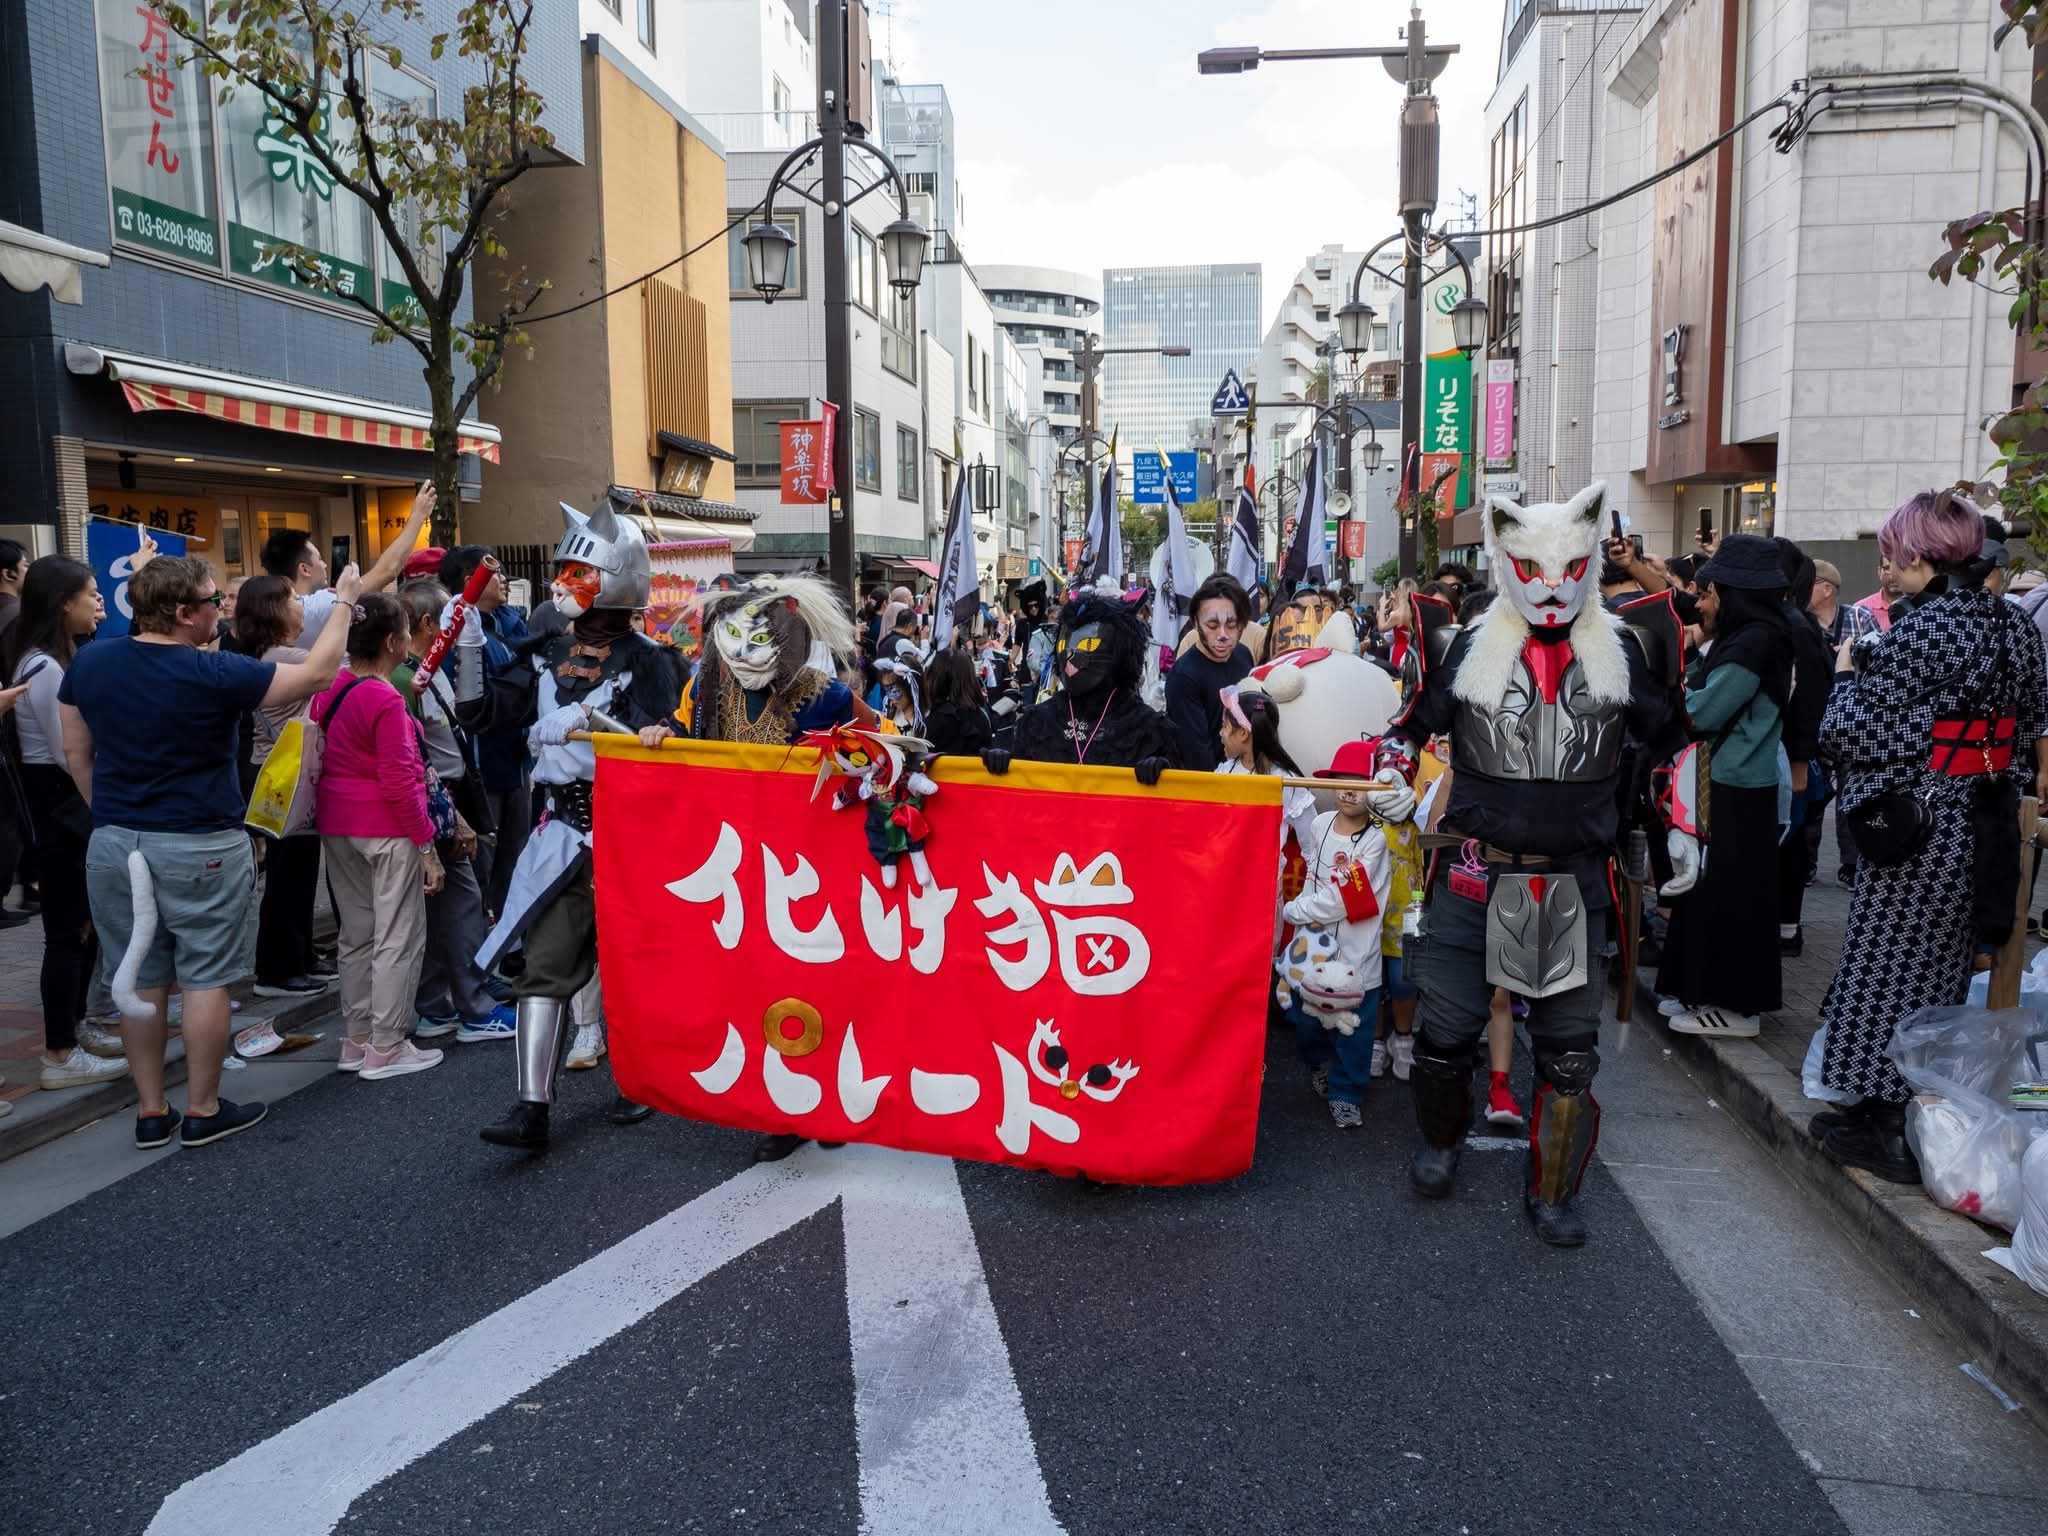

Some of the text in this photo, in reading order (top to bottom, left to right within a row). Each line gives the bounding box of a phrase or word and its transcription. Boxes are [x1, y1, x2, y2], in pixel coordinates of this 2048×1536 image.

[137, 210, 214, 256] 03-6280-8968
[1435, 377, 1460, 454] りそな
[1493, 385, 1507, 455] クリーニング
[784, 427, 818, 500] 神楽坂
[665, 820, 1152, 996] 化け猫
[690, 997, 1140, 1156] パレード
